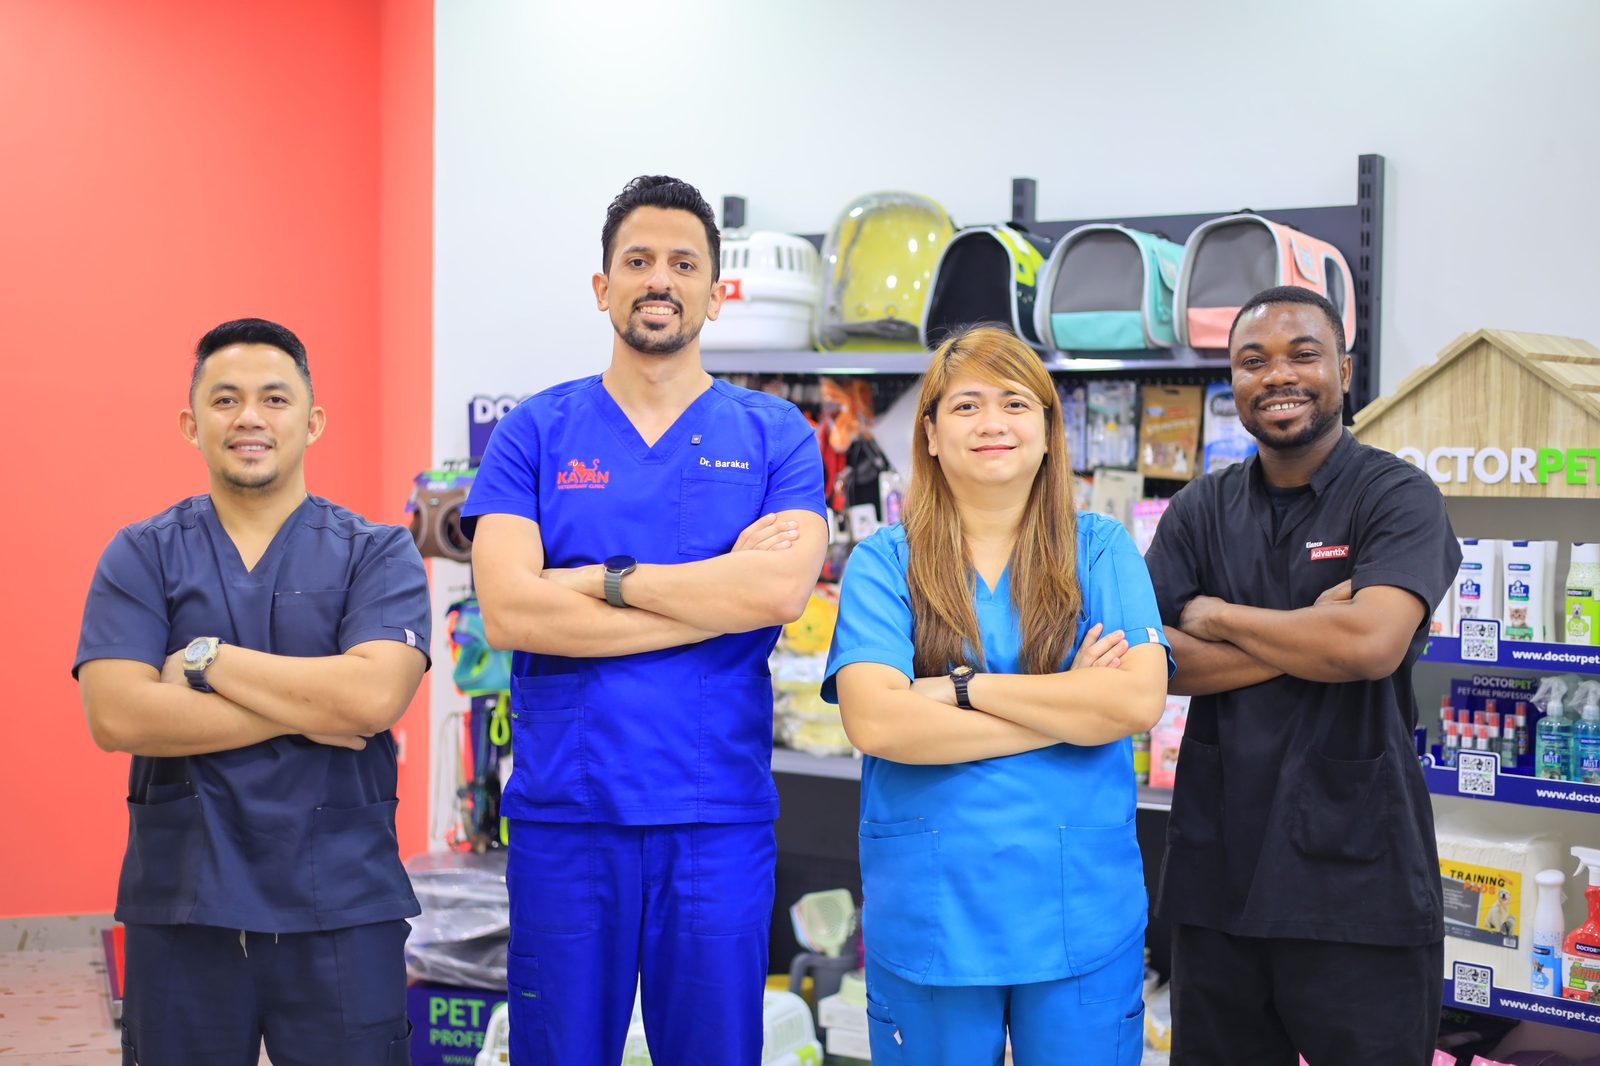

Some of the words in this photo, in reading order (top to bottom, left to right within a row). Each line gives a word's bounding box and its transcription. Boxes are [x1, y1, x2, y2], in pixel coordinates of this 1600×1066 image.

[700, 457, 712, 467] Dr.
[715, 459, 750, 470] Barakat
[557, 471, 609, 484] KAYAN
[1311, 548, 1346, 559] Advantix
[1473, 676, 1532, 689] DOCTORPET
[1457, 687, 1470, 696] PET
[1472, 688, 1491, 698] CARE
[1450, 869, 1505, 888] TRAINING
[1464, 880, 1496, 895] PADS
[429, 996, 486, 1027] PET
